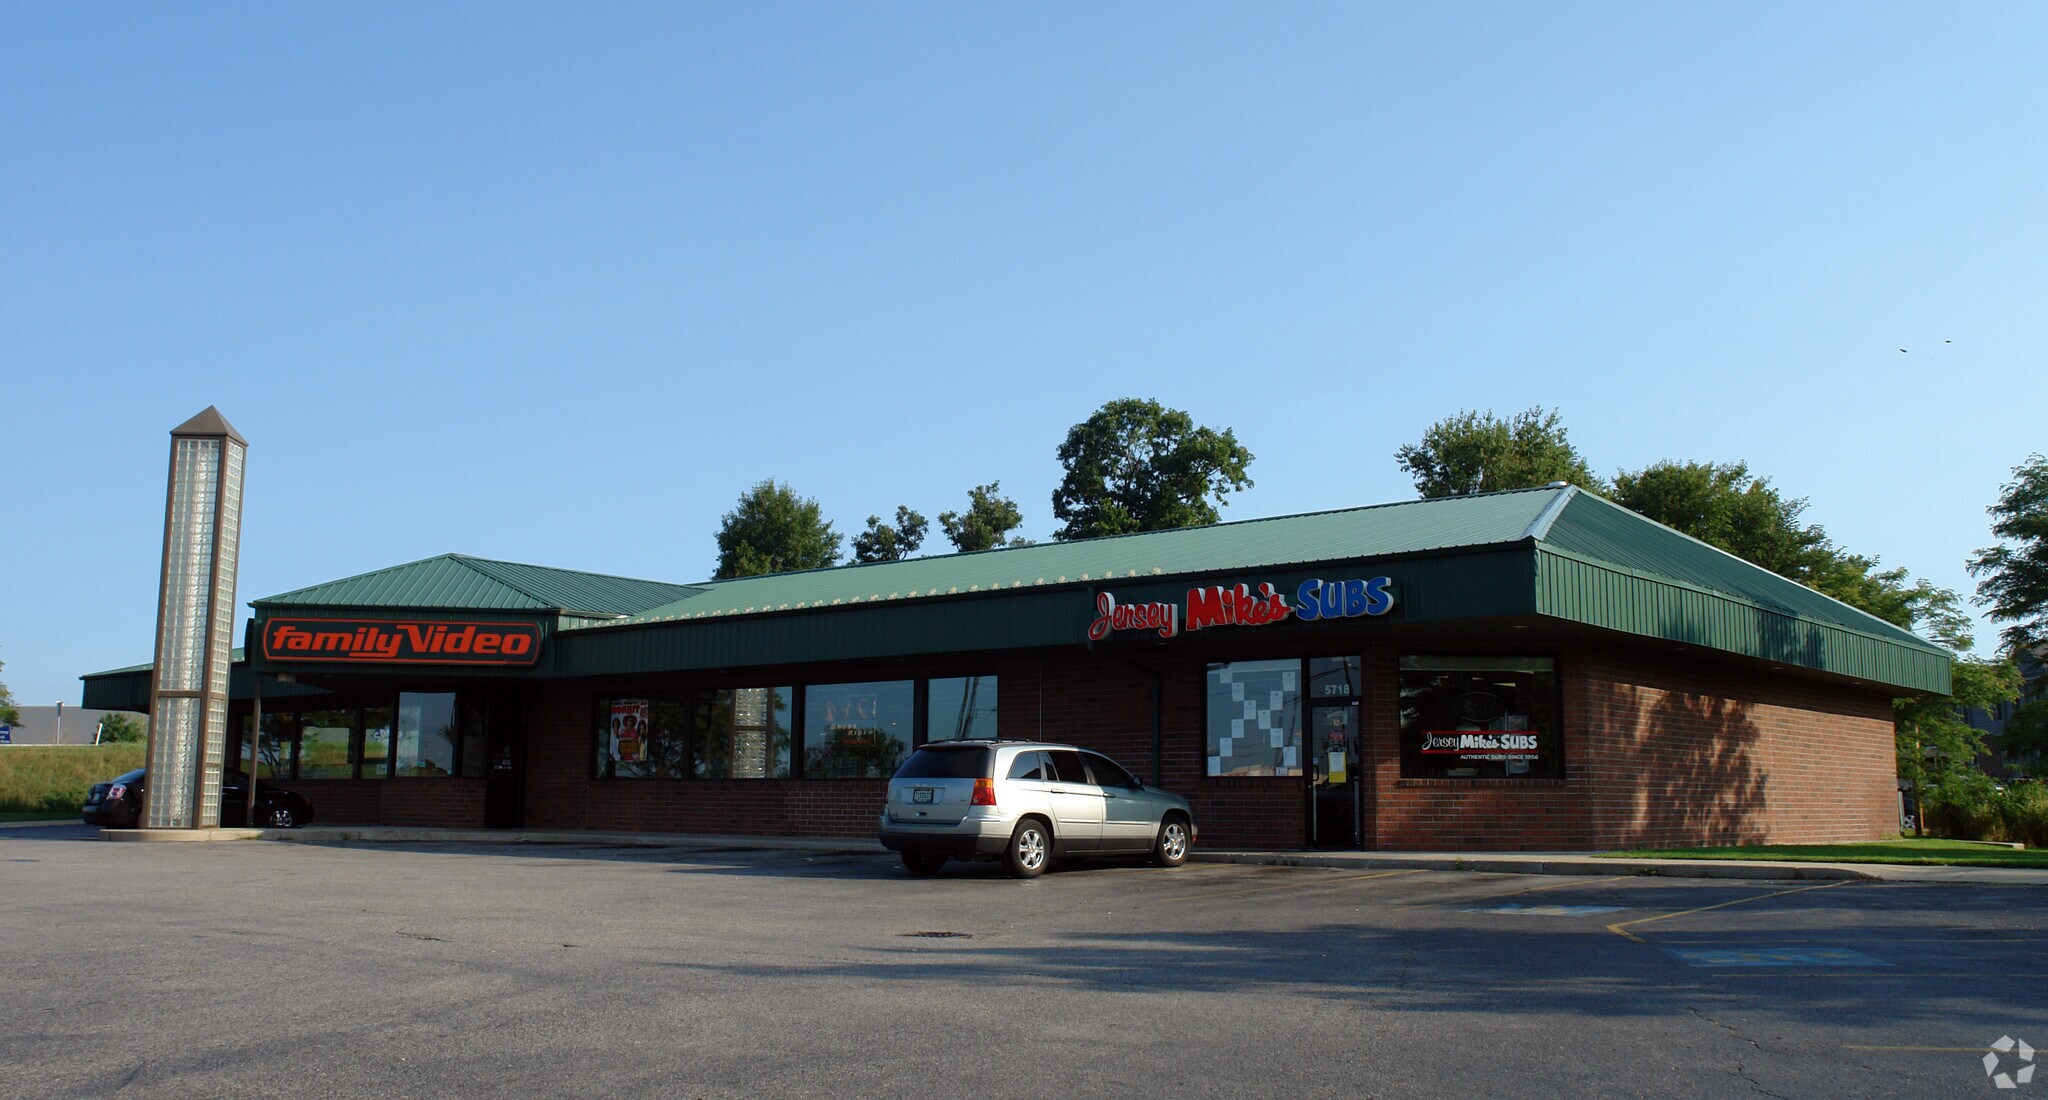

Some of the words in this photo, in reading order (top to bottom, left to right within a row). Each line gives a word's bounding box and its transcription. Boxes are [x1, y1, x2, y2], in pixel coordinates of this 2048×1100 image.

[1088, 591, 1177, 640] Jersey
[1186, 582, 1293, 631] Mike's
[1296, 577, 1393, 621] SUBS
[1324, 684, 1350, 695] 5718
[1421, 732, 1459, 751] Jersey
[1460, 735, 1500, 749] Mike's
[1501, 734, 1537, 749] SUBS
